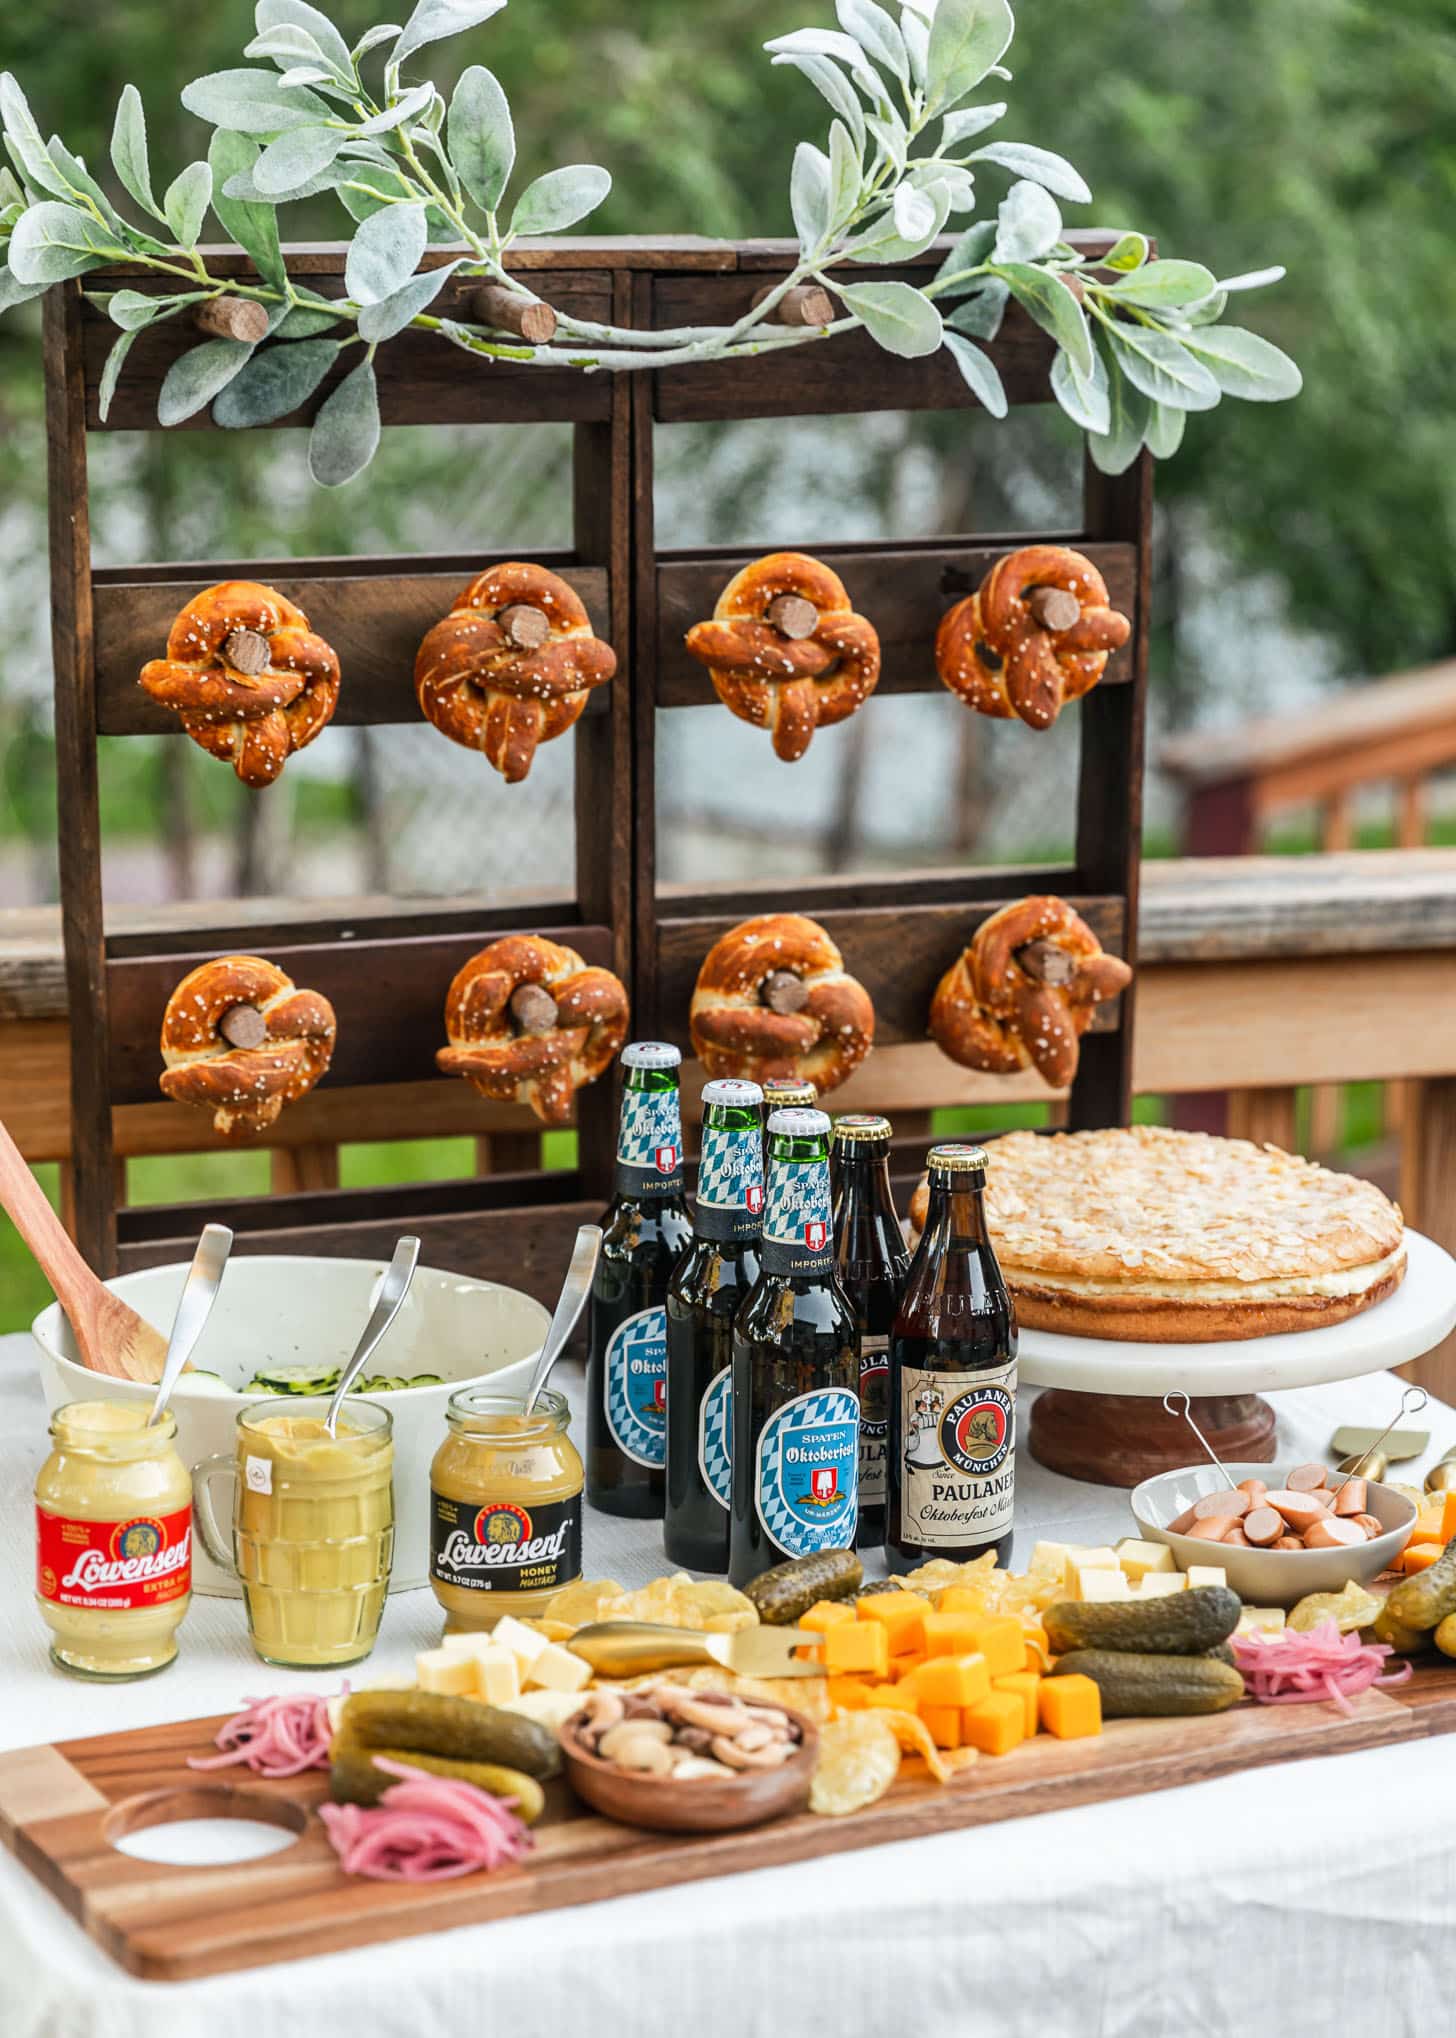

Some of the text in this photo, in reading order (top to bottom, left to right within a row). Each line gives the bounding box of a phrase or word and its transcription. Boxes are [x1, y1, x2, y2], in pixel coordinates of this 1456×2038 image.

[946, 1389, 1011, 1424] PAULANER
[801, 1430, 846, 1444] SPATEN
[786, 1442, 854, 1464] Oktoberfest
[952, 1443, 1008, 1472] MÜNCHEN
[920, 1504, 988, 1525] Oktoberfest
[438, 1519, 568, 1571] Löwensenf
[62, 1526, 191, 1590] Löwensenf
[519, 1575, 557, 1588] MUSTARD
[520, 1564, 558, 1577] HONEY
